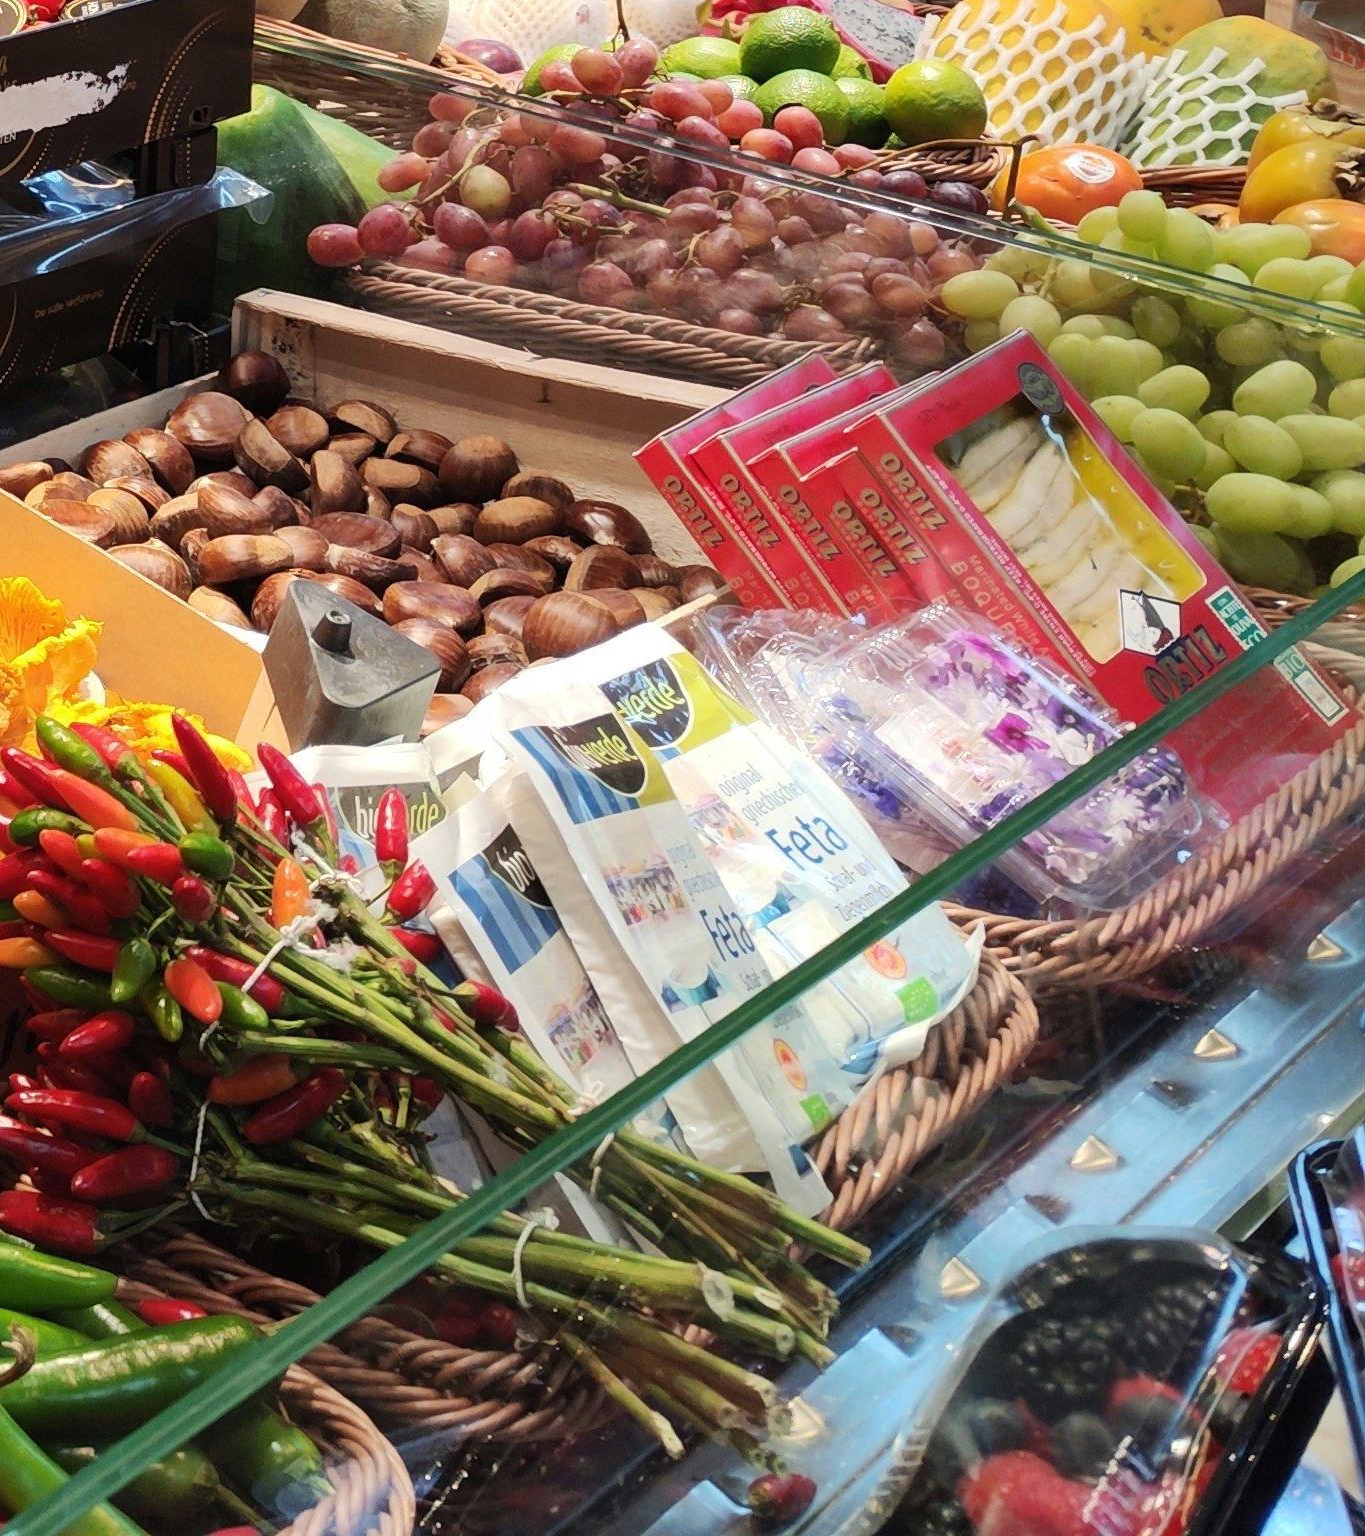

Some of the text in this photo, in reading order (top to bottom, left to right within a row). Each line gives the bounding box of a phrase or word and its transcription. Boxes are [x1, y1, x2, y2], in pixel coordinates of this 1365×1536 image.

[665, 473, 724, 548] ORTIZ
[720, 473, 782, 549] ORTIZ
[780, 484, 843, 561] ORTIZ
[859, 487, 928, 565] ORTIZ
[880, 452, 948, 531] ORTIZ
[832, 500, 900, 578] ORTIZ
[1144, 623, 1228, 706] ORTIZ
[719, 761, 764, 798] original
[765, 816, 849, 871] Feta
[699, 904, 756, 962] Feta
